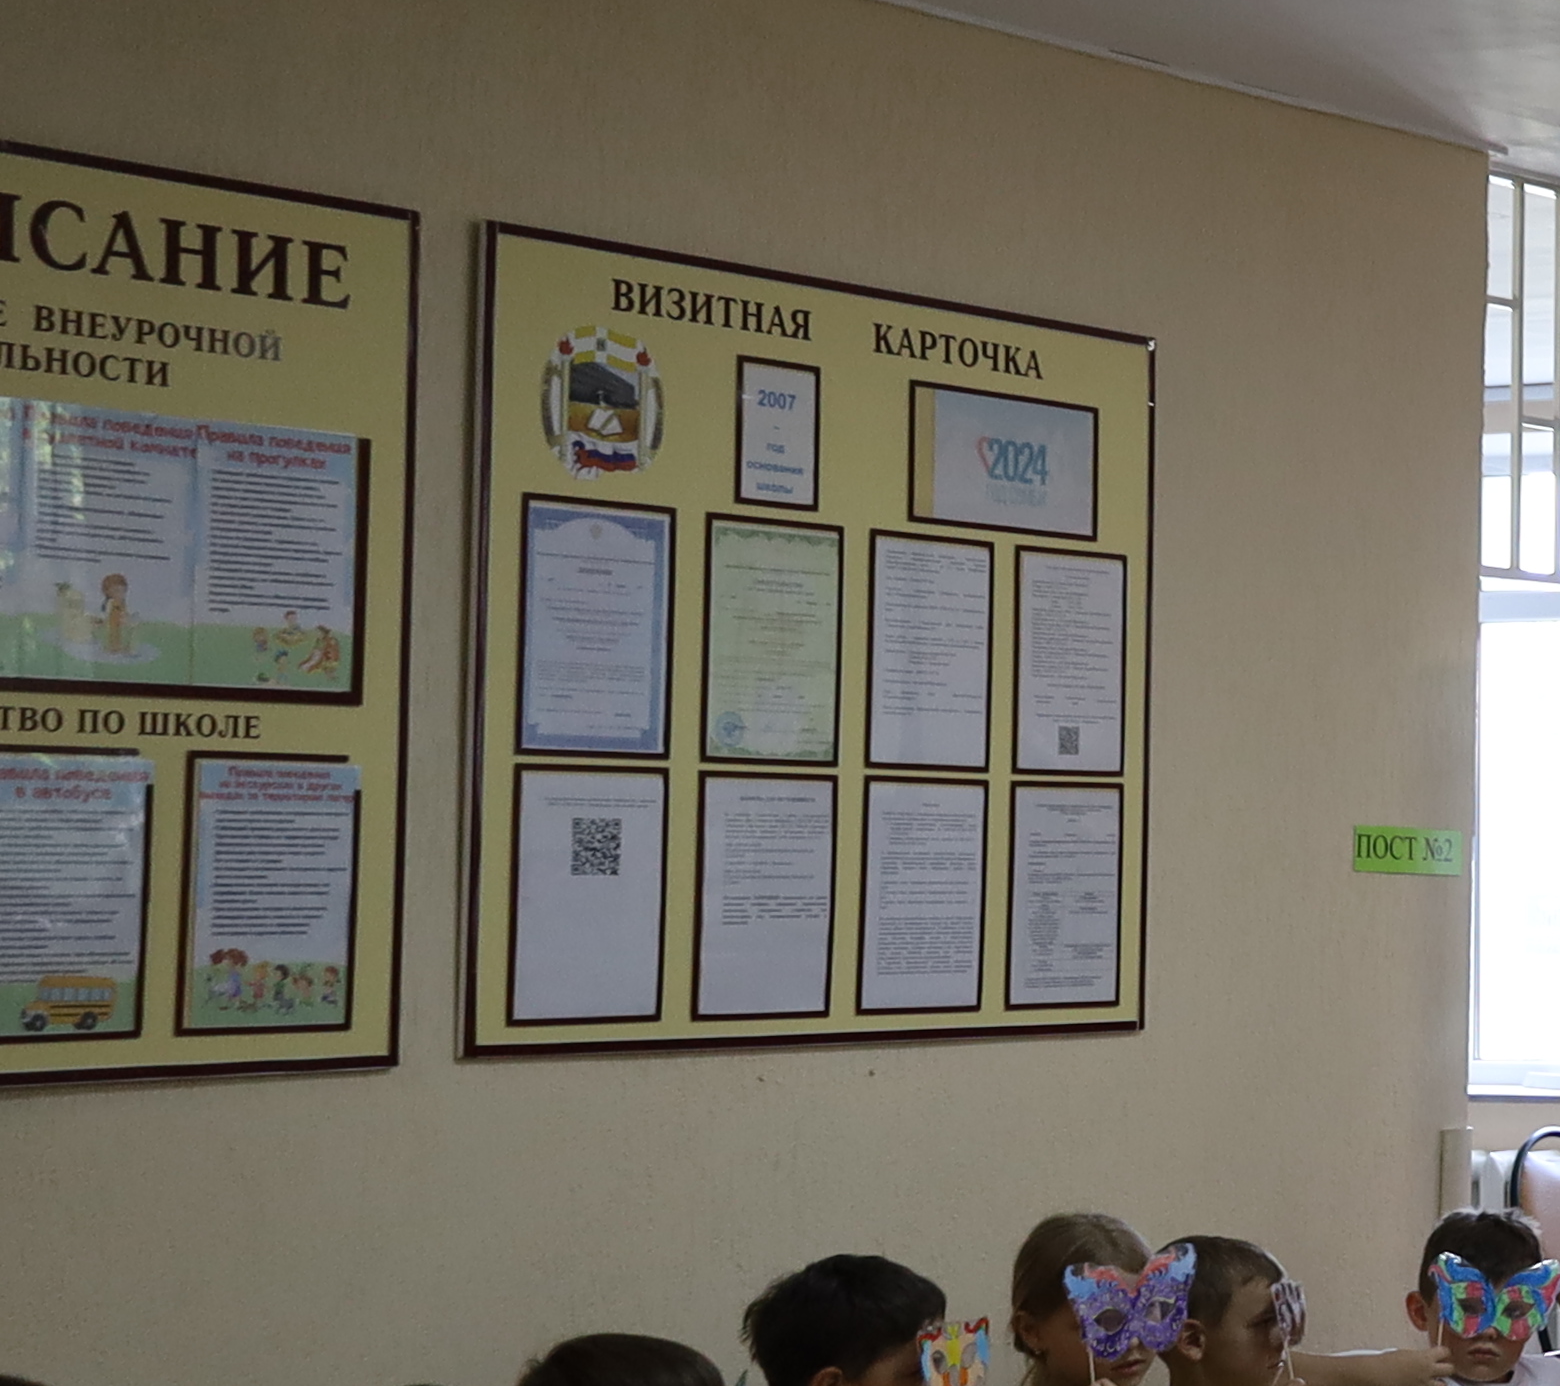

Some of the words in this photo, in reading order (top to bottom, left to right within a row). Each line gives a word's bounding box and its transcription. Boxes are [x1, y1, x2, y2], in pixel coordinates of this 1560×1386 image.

[33, 304, 282, 362] ВНЕУРОЧНОЙ
[612, 278, 812, 341] ВИЗИТНАЯ
[872, 322, 1044, 380] КАРТОЧКА
[757, 389, 797, 411] 2007
[988, 437, 1048, 486] 2024
[76, 708, 126, 735] ПО
[137, 711, 262, 740] ШКОЛЕ
[1356, 834, 1417, 860] ПОСТ
[1422, 837, 1453, 862] №2
